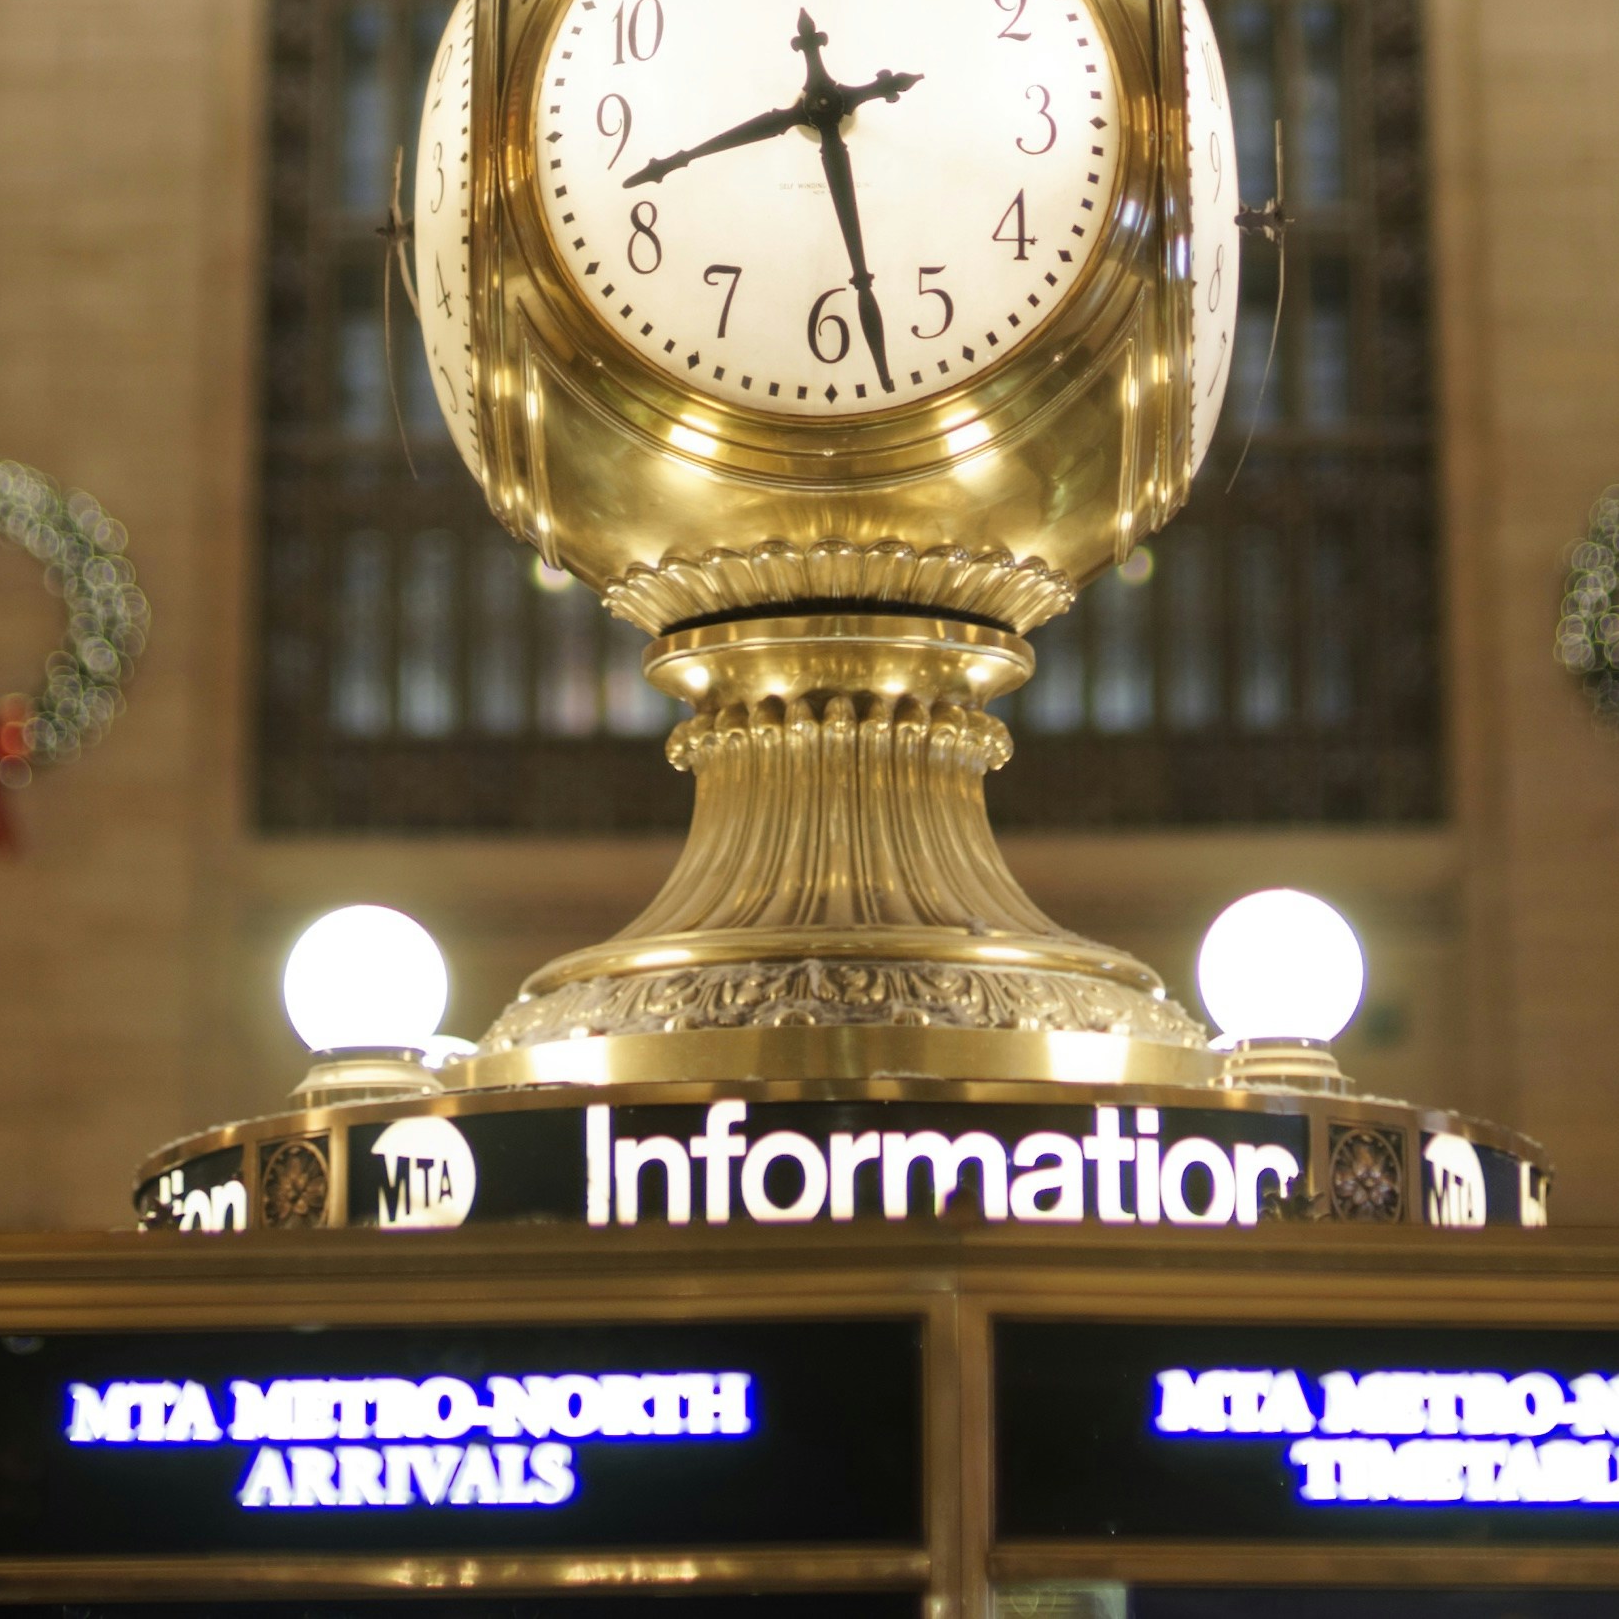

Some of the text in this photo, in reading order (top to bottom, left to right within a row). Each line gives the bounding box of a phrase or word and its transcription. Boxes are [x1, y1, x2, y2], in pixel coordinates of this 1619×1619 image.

[596, 94, 632, 170] 9
[1016, 84, 1058, 155] 3
[429, 142, 445, 214] 3
[1209, 131, 1222, 204] 9
[626, 200, 663, 276] 8
[991, 188, 1040, 262] 4
[434, 249, 453, 320] 4
[702, 263, 743, 340] 7
[910, 265, 956, 341] 5
[1207, 242, 1225, 313] 8
[807, 287, 851, 366] 6
[586, 1099, 1301, 1227] Information
[67, 1372, 751, 1442] MTA METRO-NORTH
[1154, 1369, 1316, 1434] MTA
[239, 1443, 576, 1507] ARRIVALS
